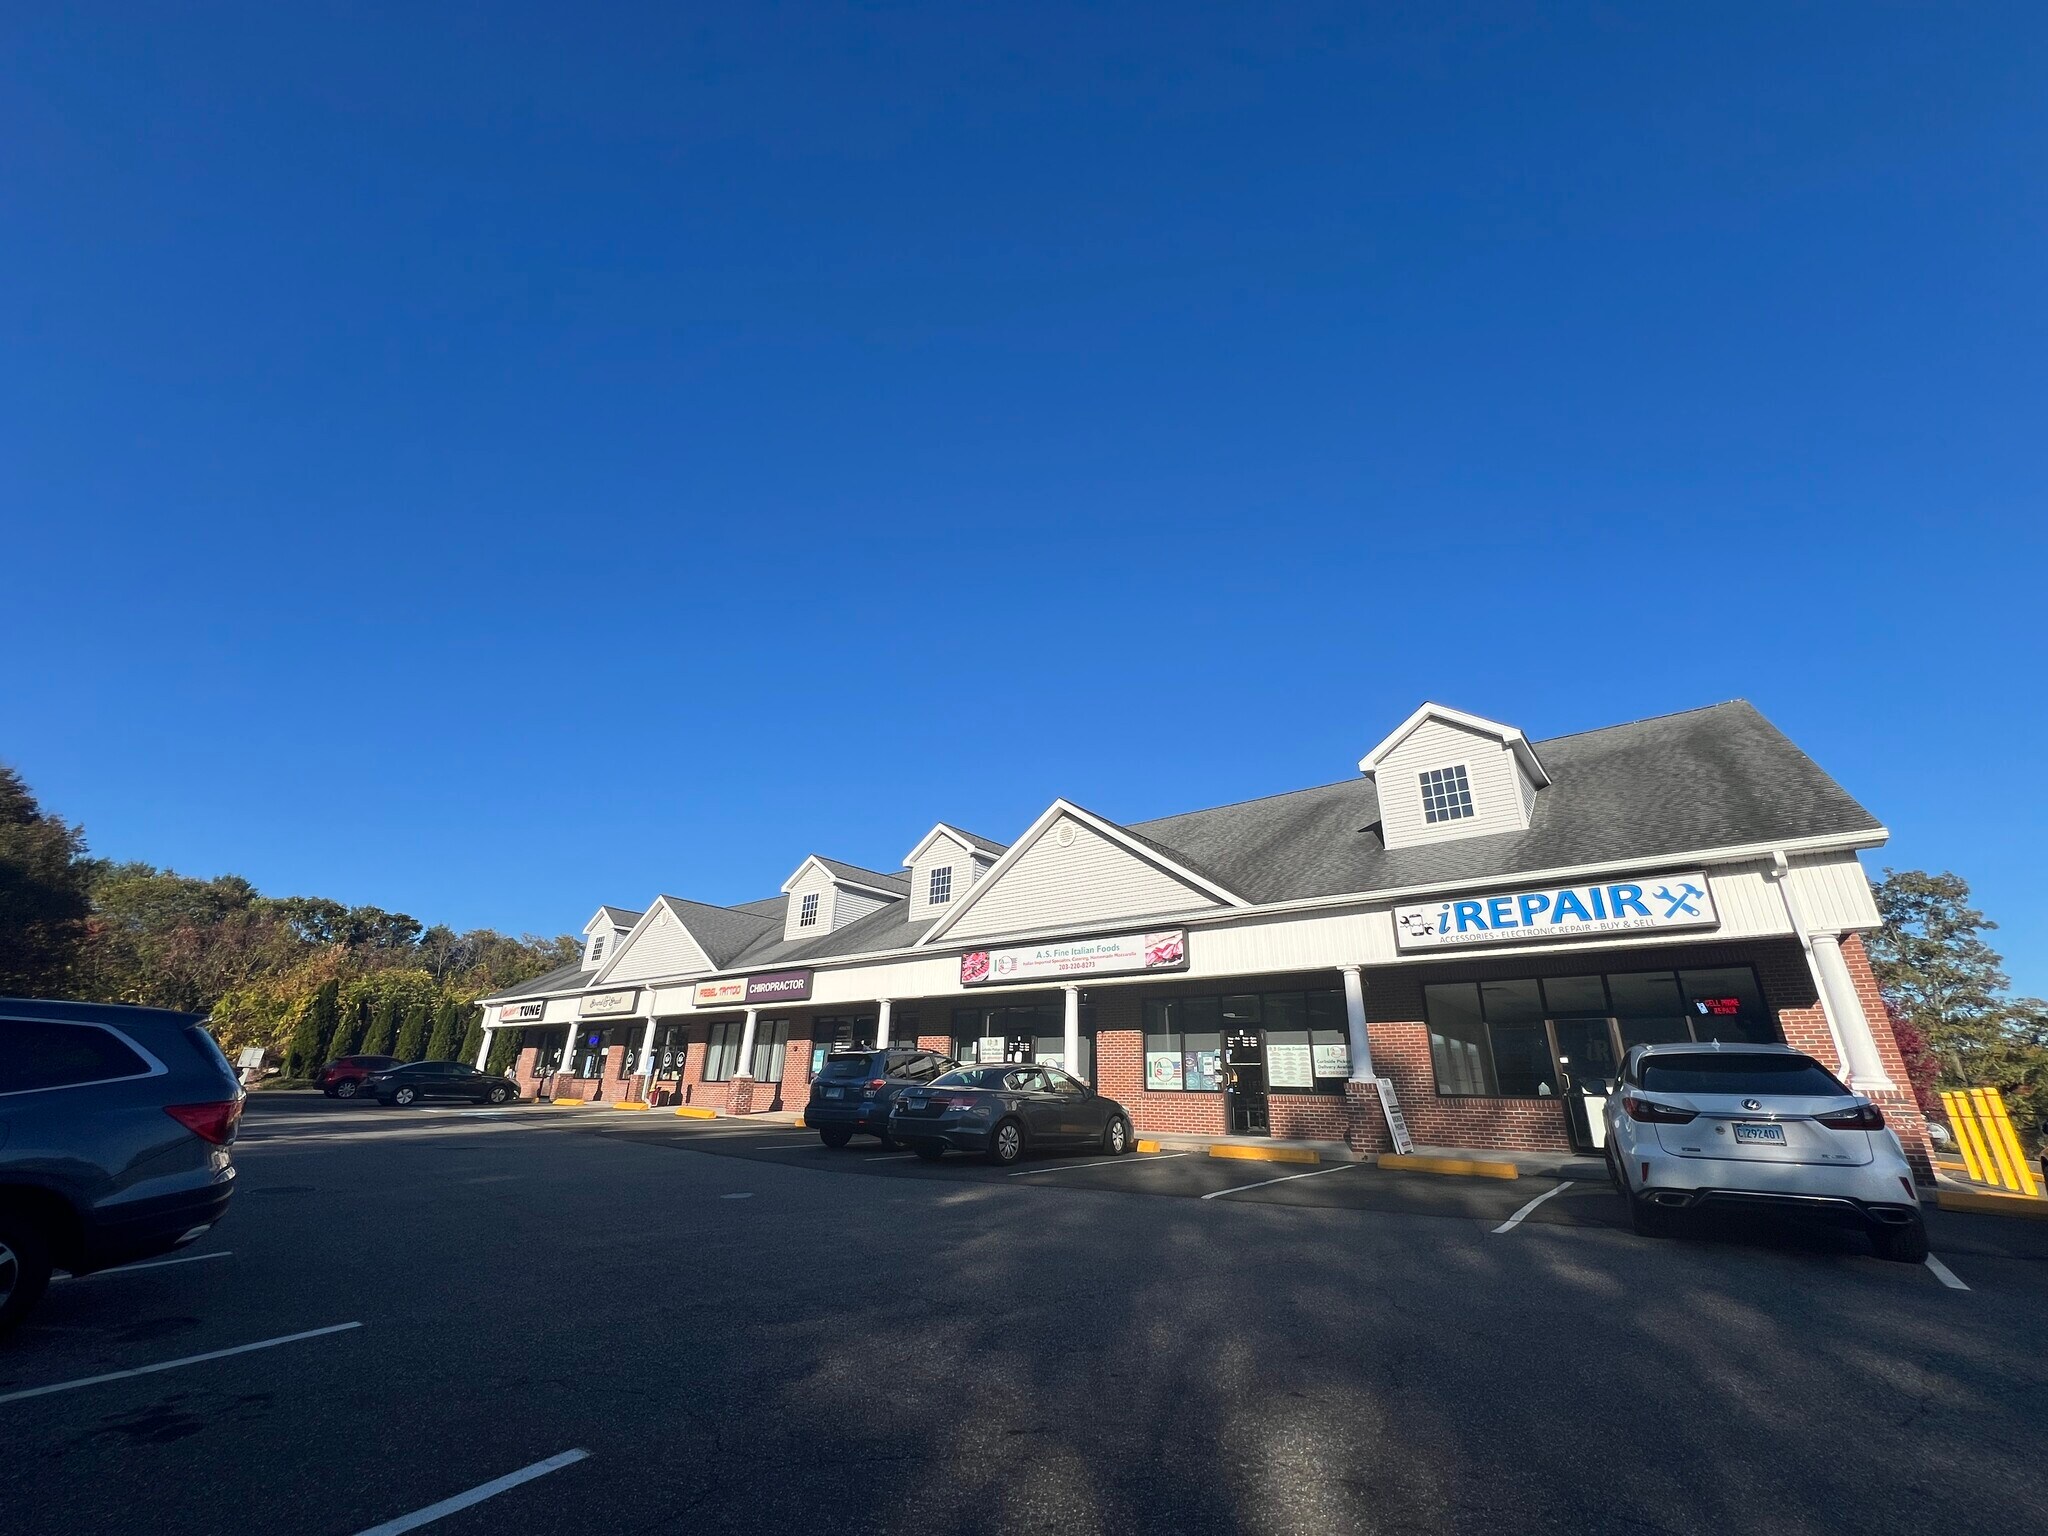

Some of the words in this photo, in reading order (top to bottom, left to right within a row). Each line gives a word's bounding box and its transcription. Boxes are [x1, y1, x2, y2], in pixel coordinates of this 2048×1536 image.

[1437, 884, 1652, 934] iREPAIR
[1440, 932, 1494, 944] ACCESSORIES
[1501, 927, 1557, 939] ELECTRONIC
[1559, 924, 1592, 934] REPAIR
[1600, 921, 1620, 931] BUY
[1623, 920, 1631, 928] &
[1633, 918, 1657, 927] SELL
[1036, 951, 1052, 959] A.S.
[1053, 949, 1069, 957] Fine
[1071, 946, 1095, 956] Italian
[1096, 943, 1120, 953] Foods
[749, 979, 804, 994] CHIROPRACTOR
[519, 1004, 541, 1017] TUNE
